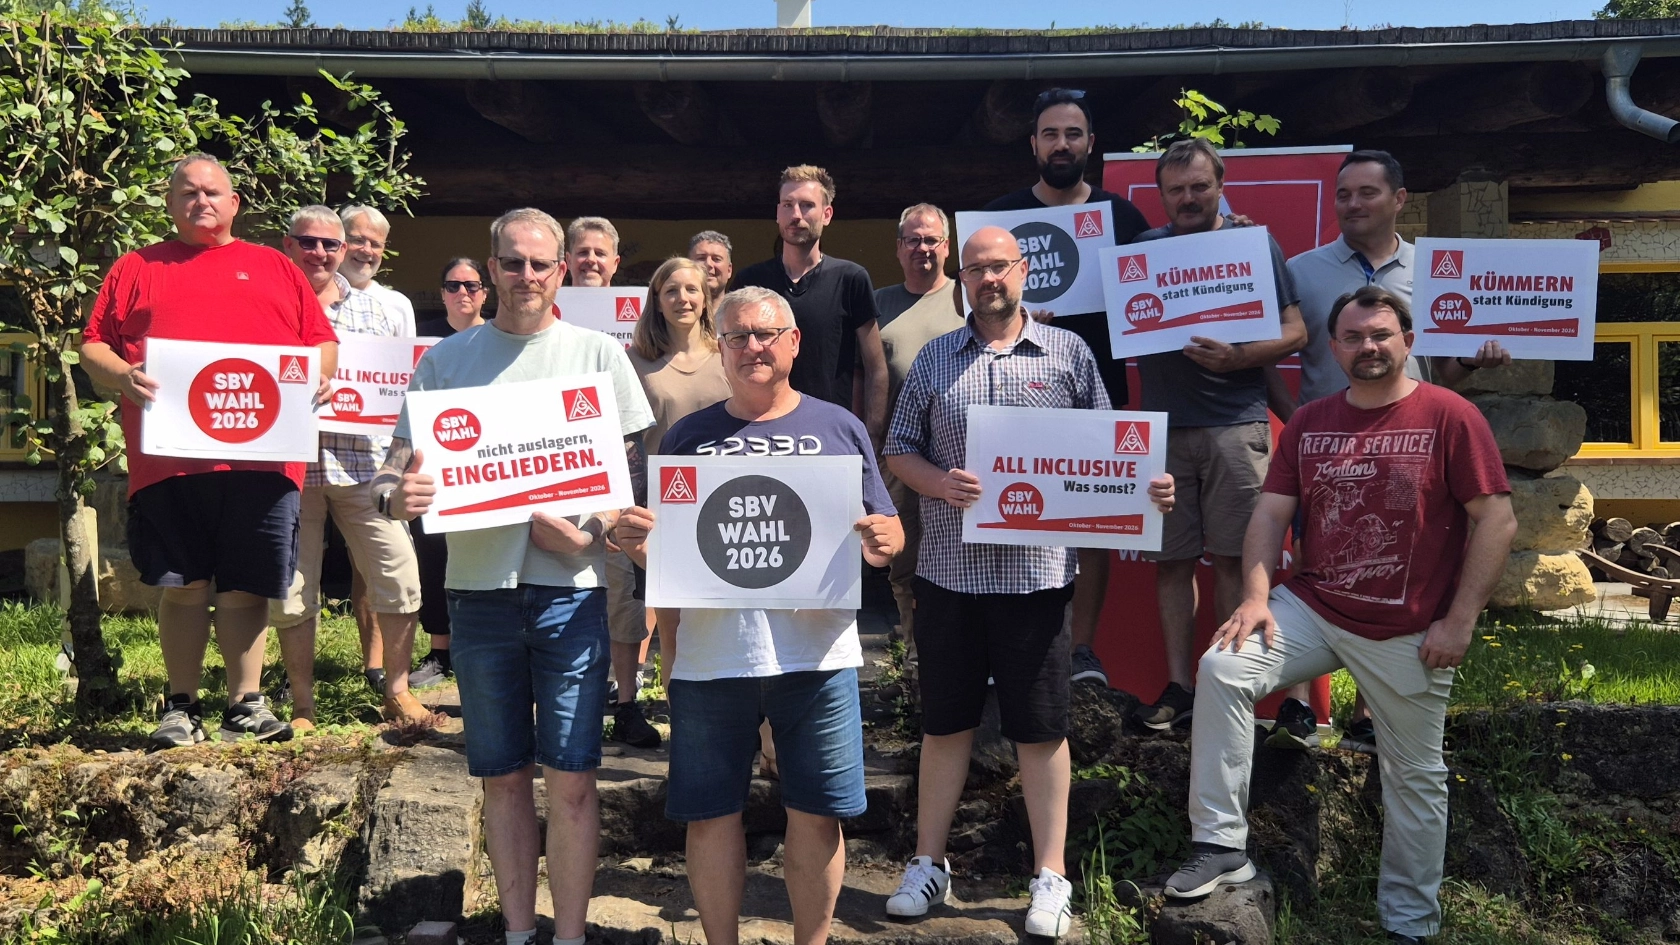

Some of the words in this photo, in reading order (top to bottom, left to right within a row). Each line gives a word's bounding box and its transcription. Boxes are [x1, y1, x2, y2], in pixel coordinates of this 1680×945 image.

[1016, 234, 1052, 255] SBV
[1024, 252, 1064, 272] AHL
[1156, 261, 1252, 288] KÜMMERN
[1470, 271, 1574, 292] KÜMMERN
[1162, 287, 1190, 301] statt
[1192, 281, 1255, 296] Kündigung
[1131, 298, 1154, 311] SBV
[1438, 300, 1463, 310] SBV
[1473, 296, 1502, 306] statt
[1505, 296, 1573, 308] Kündigung
[1127, 308, 1161, 322] WAHL
[1433, 310, 1468, 320] WAHL
[213, 372, 254, 390] SBV
[357, 370, 414, 385] INCLUSI
[337, 393, 357, 403] SBV
[379, 388, 398, 396] Was
[204, 392, 265, 410] WAHL
[332, 402, 361, 412] WAHL
[210, 411, 260, 430] 2026
[440, 414, 468, 429] SBV
[435, 426, 479, 443] WAHL
[477, 442, 514, 459] nicht
[517, 433, 593, 453] auslagern,
[1303, 437, 1357, 454] REPAIR
[1362, 434, 1430, 454] SERVICE
[441, 448, 603, 487] EINGLIEDERN.
[992, 456, 1027, 474] ALL
[1033, 457, 1137, 478] INCLUSIVE
[528, 492, 554, 501] Oktober
[558, 487, 589, 496] November
[590, 484, 606, 492] 2026
[1007, 490, 1033, 502] SBV
[1064, 480, 1090, 493] Was
[1094, 482, 1136, 495] sonst?
[729, 495, 778, 518] SBV
[1001, 503, 1040, 515] WAHL
[718, 520, 790, 544] WAHL
[726, 546, 784, 570] 2026
